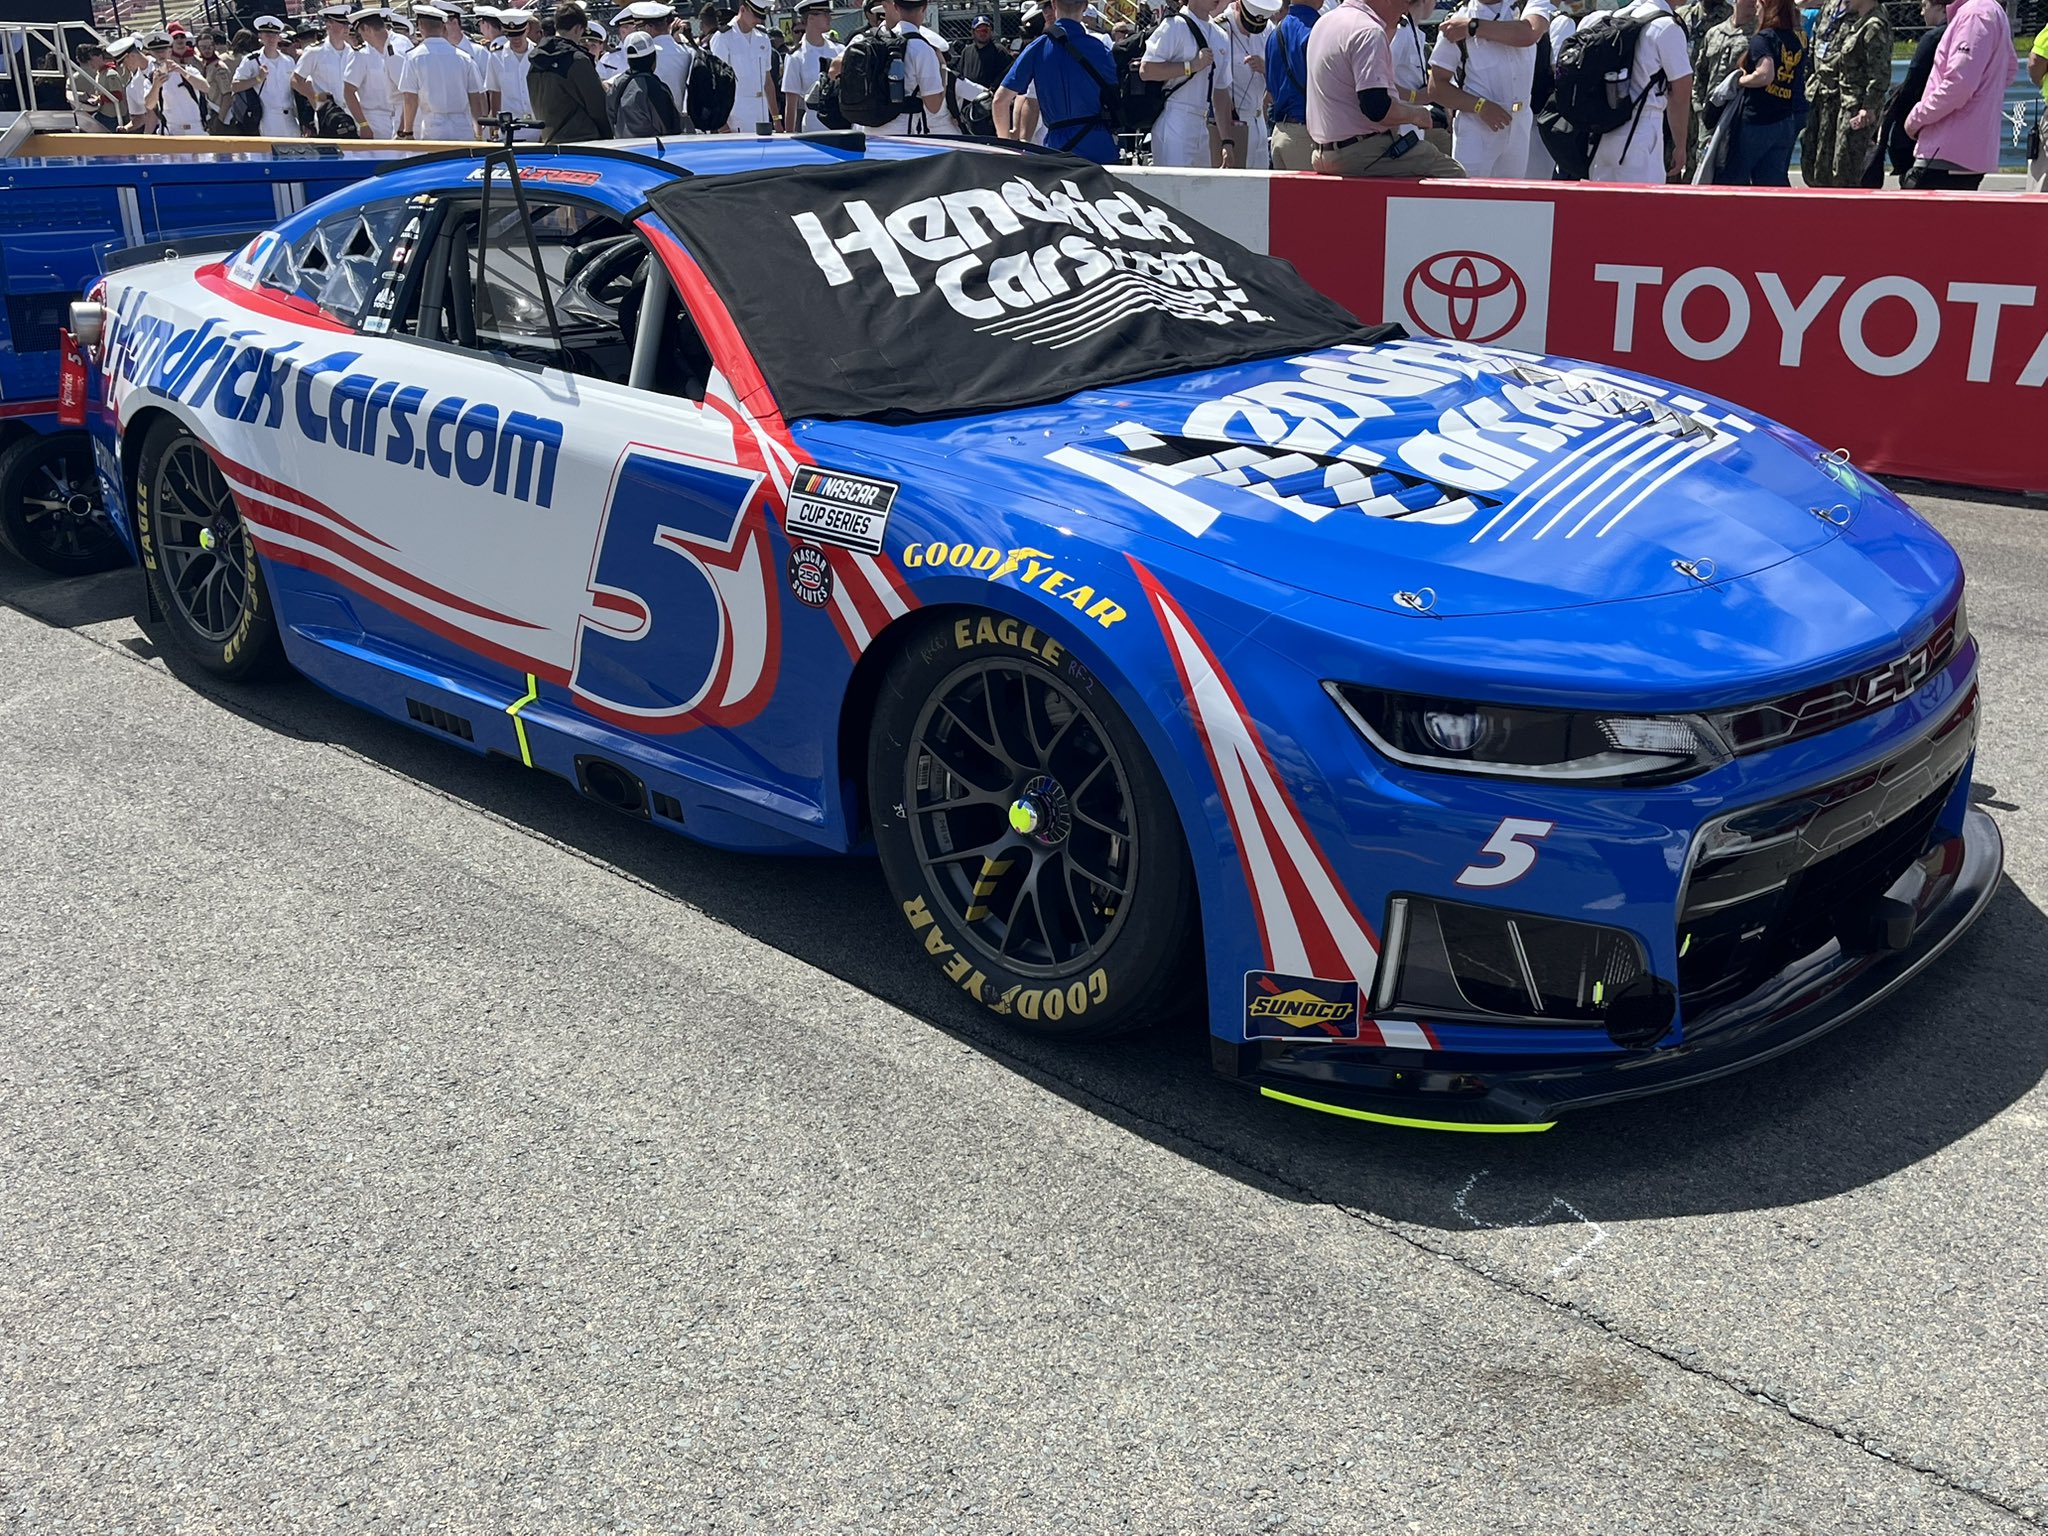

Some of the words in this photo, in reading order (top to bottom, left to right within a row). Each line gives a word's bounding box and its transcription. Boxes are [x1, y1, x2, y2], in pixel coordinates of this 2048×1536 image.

[789, 175, 1194, 298] Hendrick
[824, 477, 879, 505] NASCAR
[136, 482, 157, 571] EAGLE
[799, 503, 827, 527] CUP
[824, 508, 871, 536] SERIES
[567, 440, 768, 718] 5
[792, 549, 827, 572] NASCAR
[799, 568, 821, 584] 250
[792, 579, 828, 603] SALUTES
[902, 542, 1128, 629] GOODYEAR
[954, 616, 1065, 667] EAGLE
[1067, 659, 1095, 696] RF-2
[1456, 816, 1554, 888] 5
[902, 894, 1109, 1021] GOODYEAR
[1252, 997, 1349, 1019] SUNOCO
